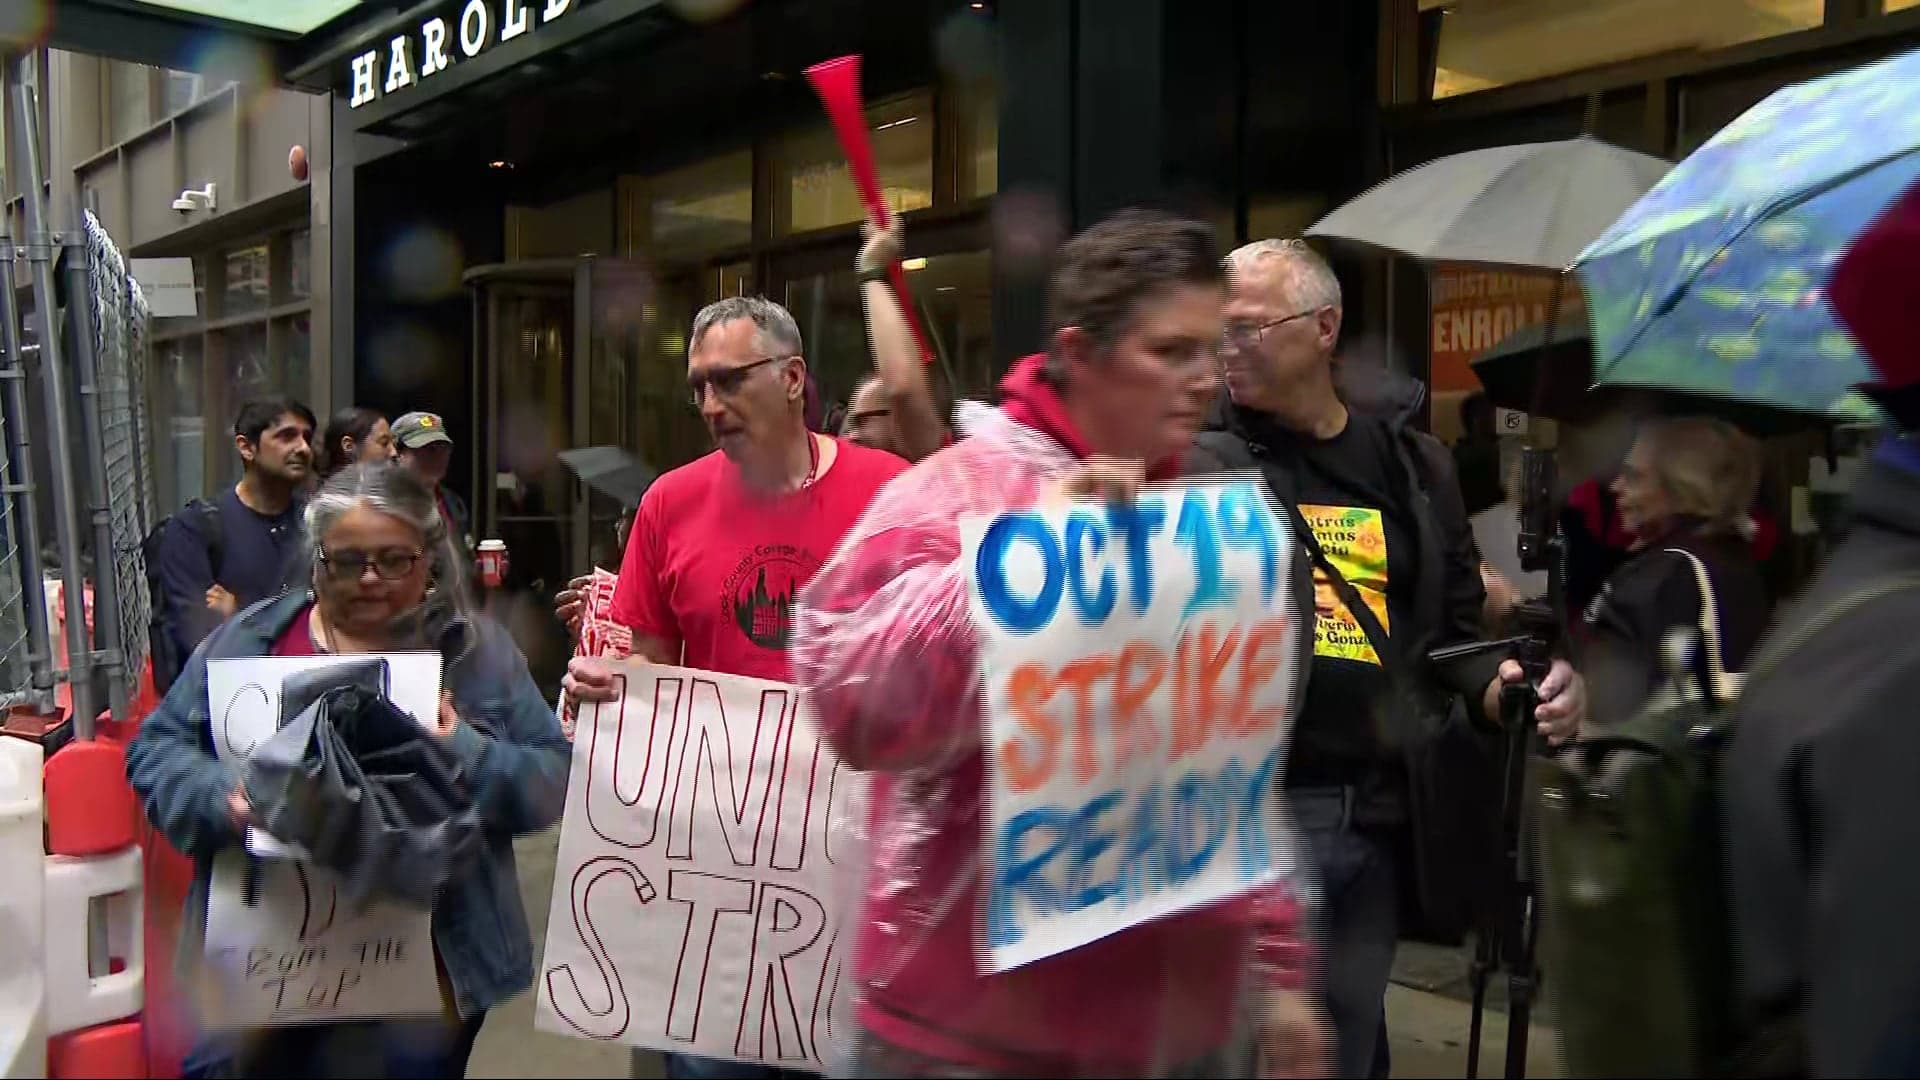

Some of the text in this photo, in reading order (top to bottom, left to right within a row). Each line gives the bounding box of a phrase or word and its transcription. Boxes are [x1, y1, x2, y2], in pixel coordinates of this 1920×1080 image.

[975, 482, 1281, 637] OCT 19
[1316, 531, 1357, 542] mos
[1319, 619, 1357, 632] verio
[1326, 630, 1364, 645] Gonz
[586, 674, 838, 871] UNI
[1000, 618, 1288, 793] STRIKE
[987, 747, 1280, 947] READY
